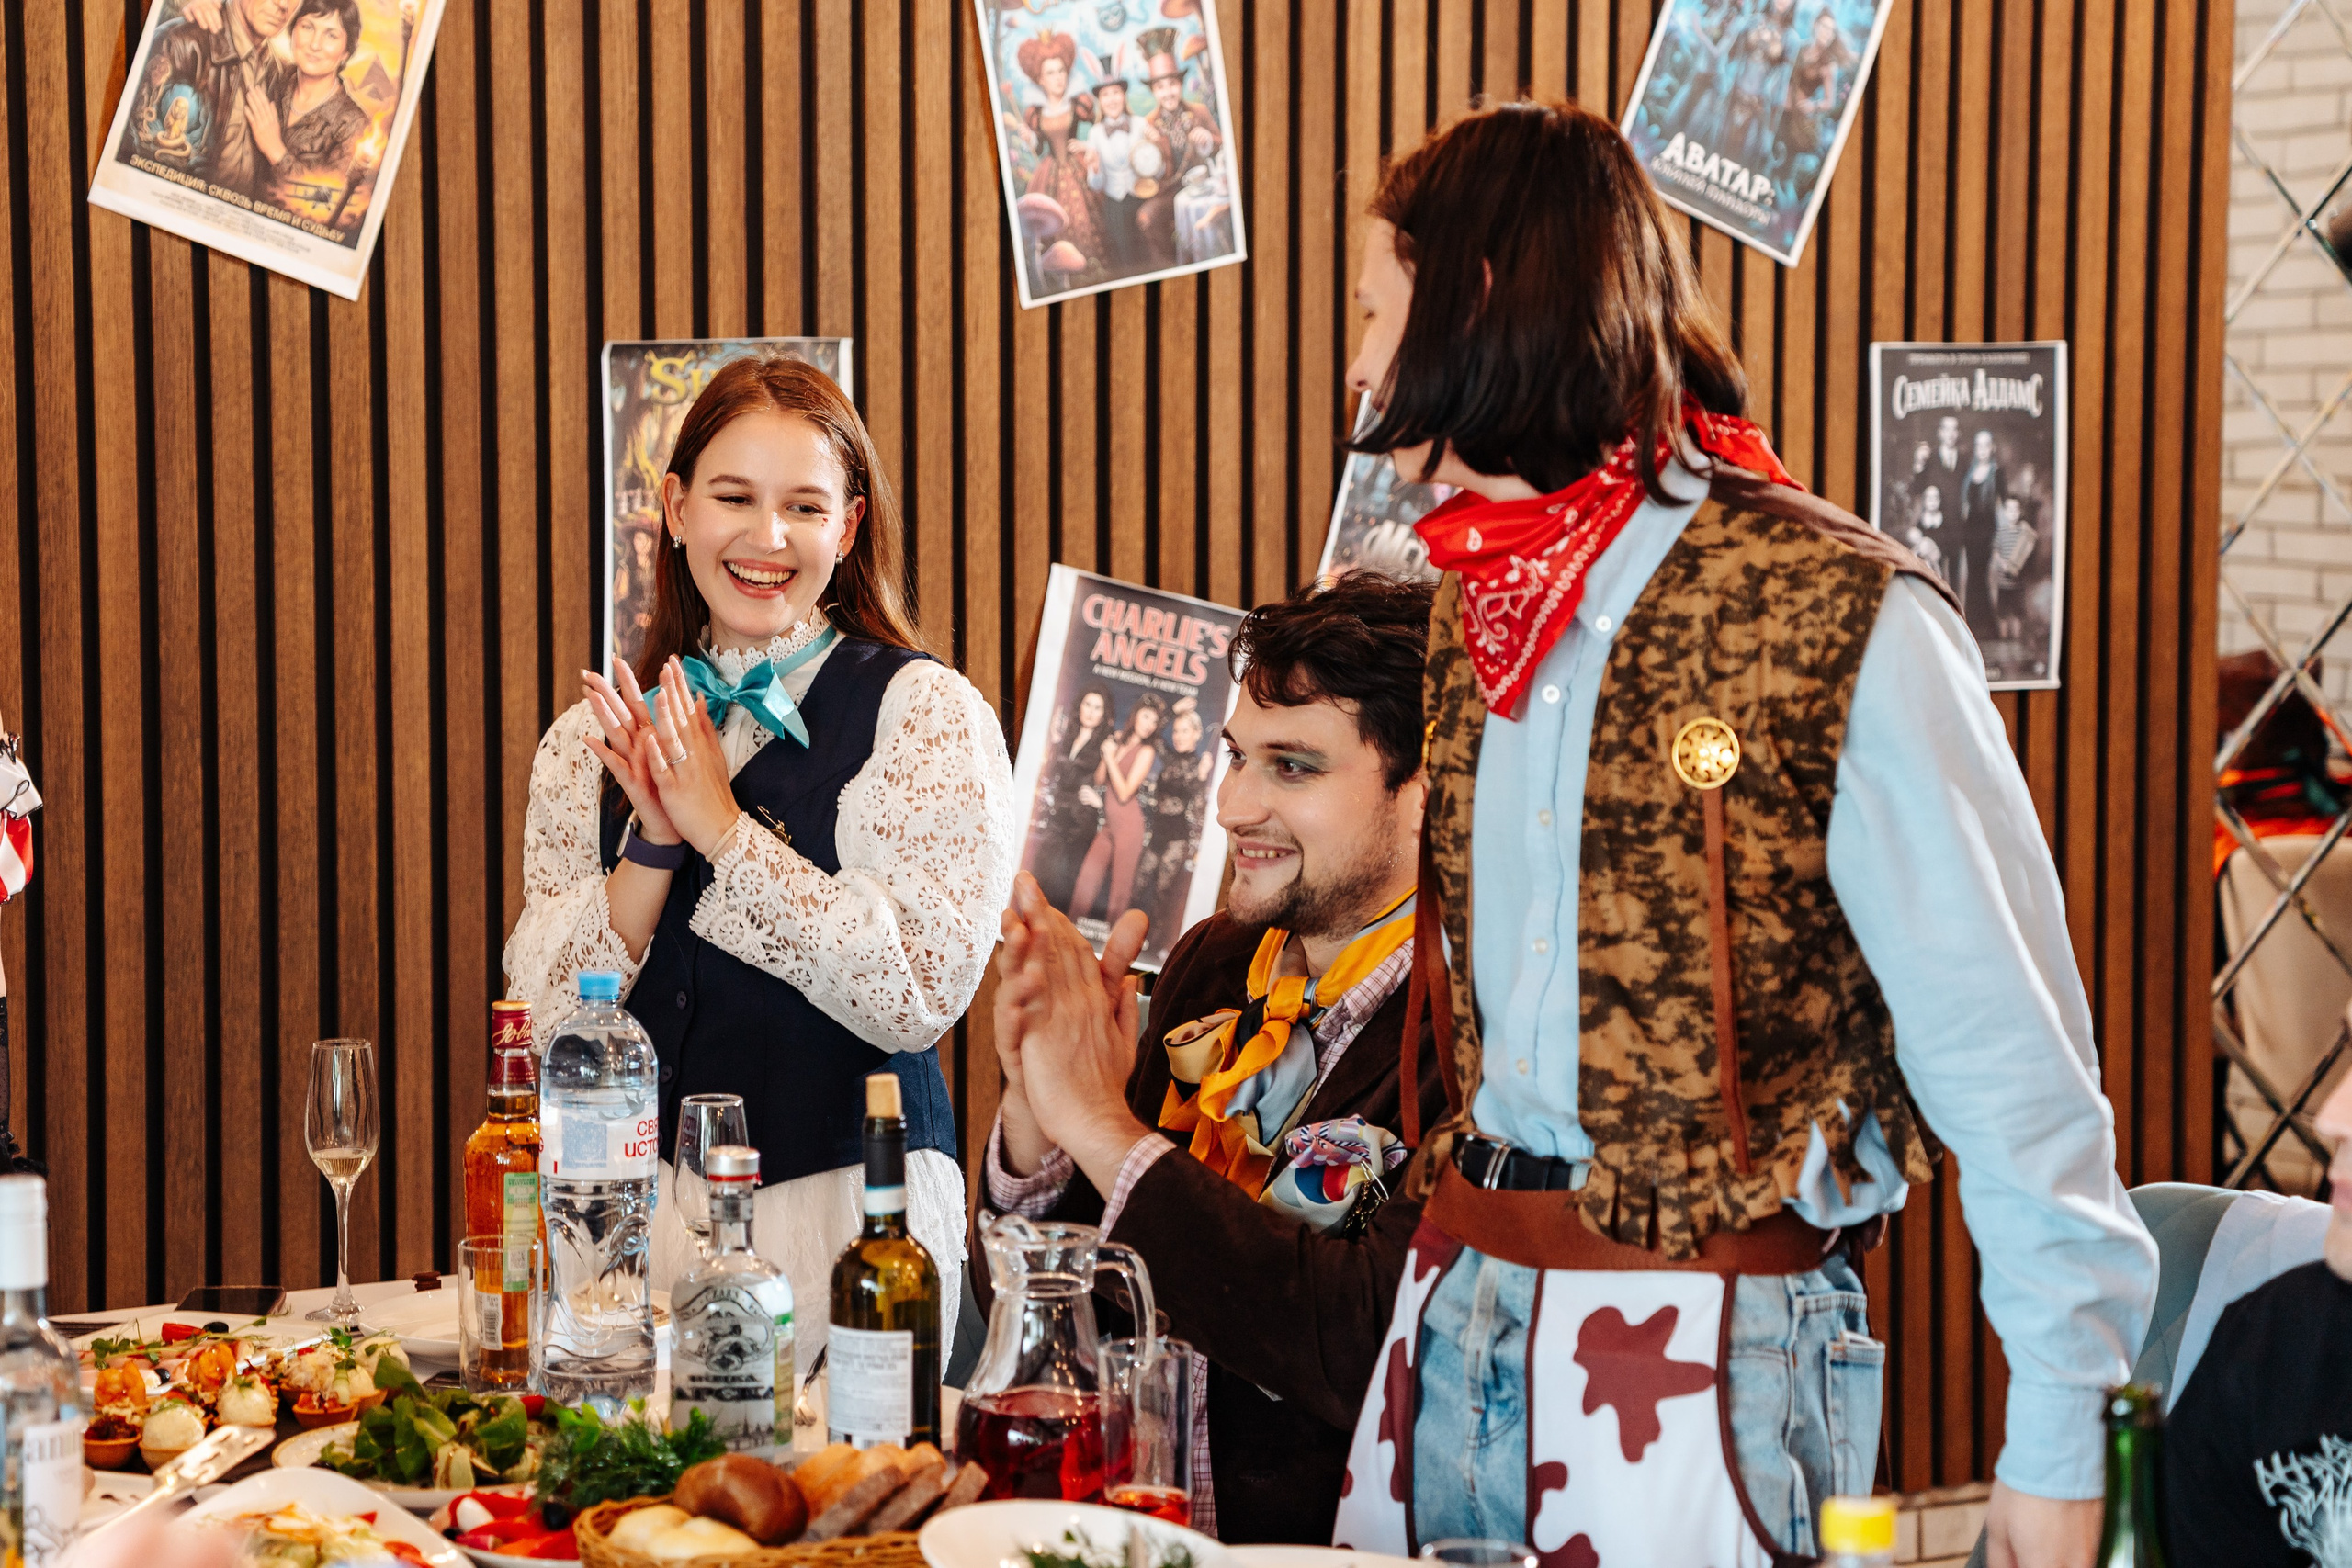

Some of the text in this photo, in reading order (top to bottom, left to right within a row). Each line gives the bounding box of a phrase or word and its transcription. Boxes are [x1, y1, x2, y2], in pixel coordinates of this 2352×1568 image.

[1661, 131, 1775, 206] АВАТАР:
[209, 184, 253, 210] СКВОЗЬ
[253, 201, 292, 223] ВРЕМЯ
[291, 215, 302, 228] И
[301, 219, 345, 243] СУДЬБУ
[1892, 373, 1970, 420] СЕМЕЙКА
[1082, 593, 1232, 659] CHARLIE'S
[1090, 630, 1208, 686] ANGELS
